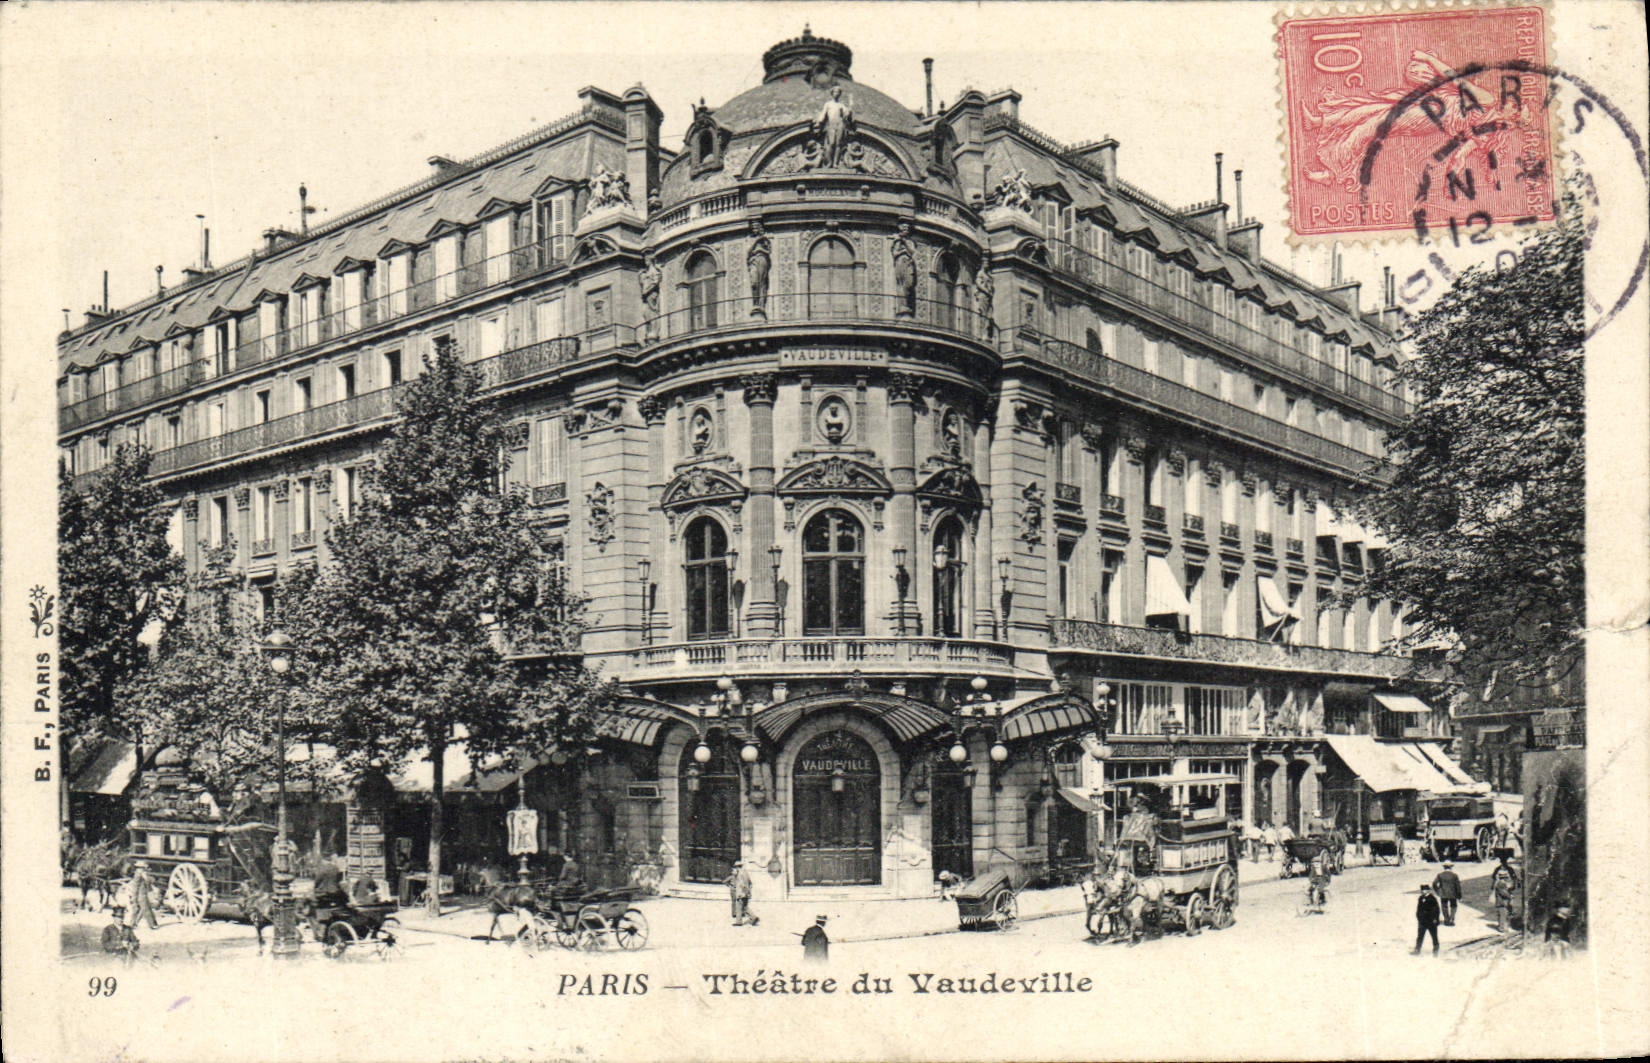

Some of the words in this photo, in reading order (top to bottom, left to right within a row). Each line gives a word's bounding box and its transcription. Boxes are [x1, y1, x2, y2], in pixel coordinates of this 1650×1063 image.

[1517, 16, 1538, 102] REPUBQUE
[1523, 130, 1545, 212] FRANAISE
[1311, 202, 1394, 224] POSTES
[791, 348, 878, 361] VAUDEVILLE
[802, 758, 872, 771] VAUDEVILLE
